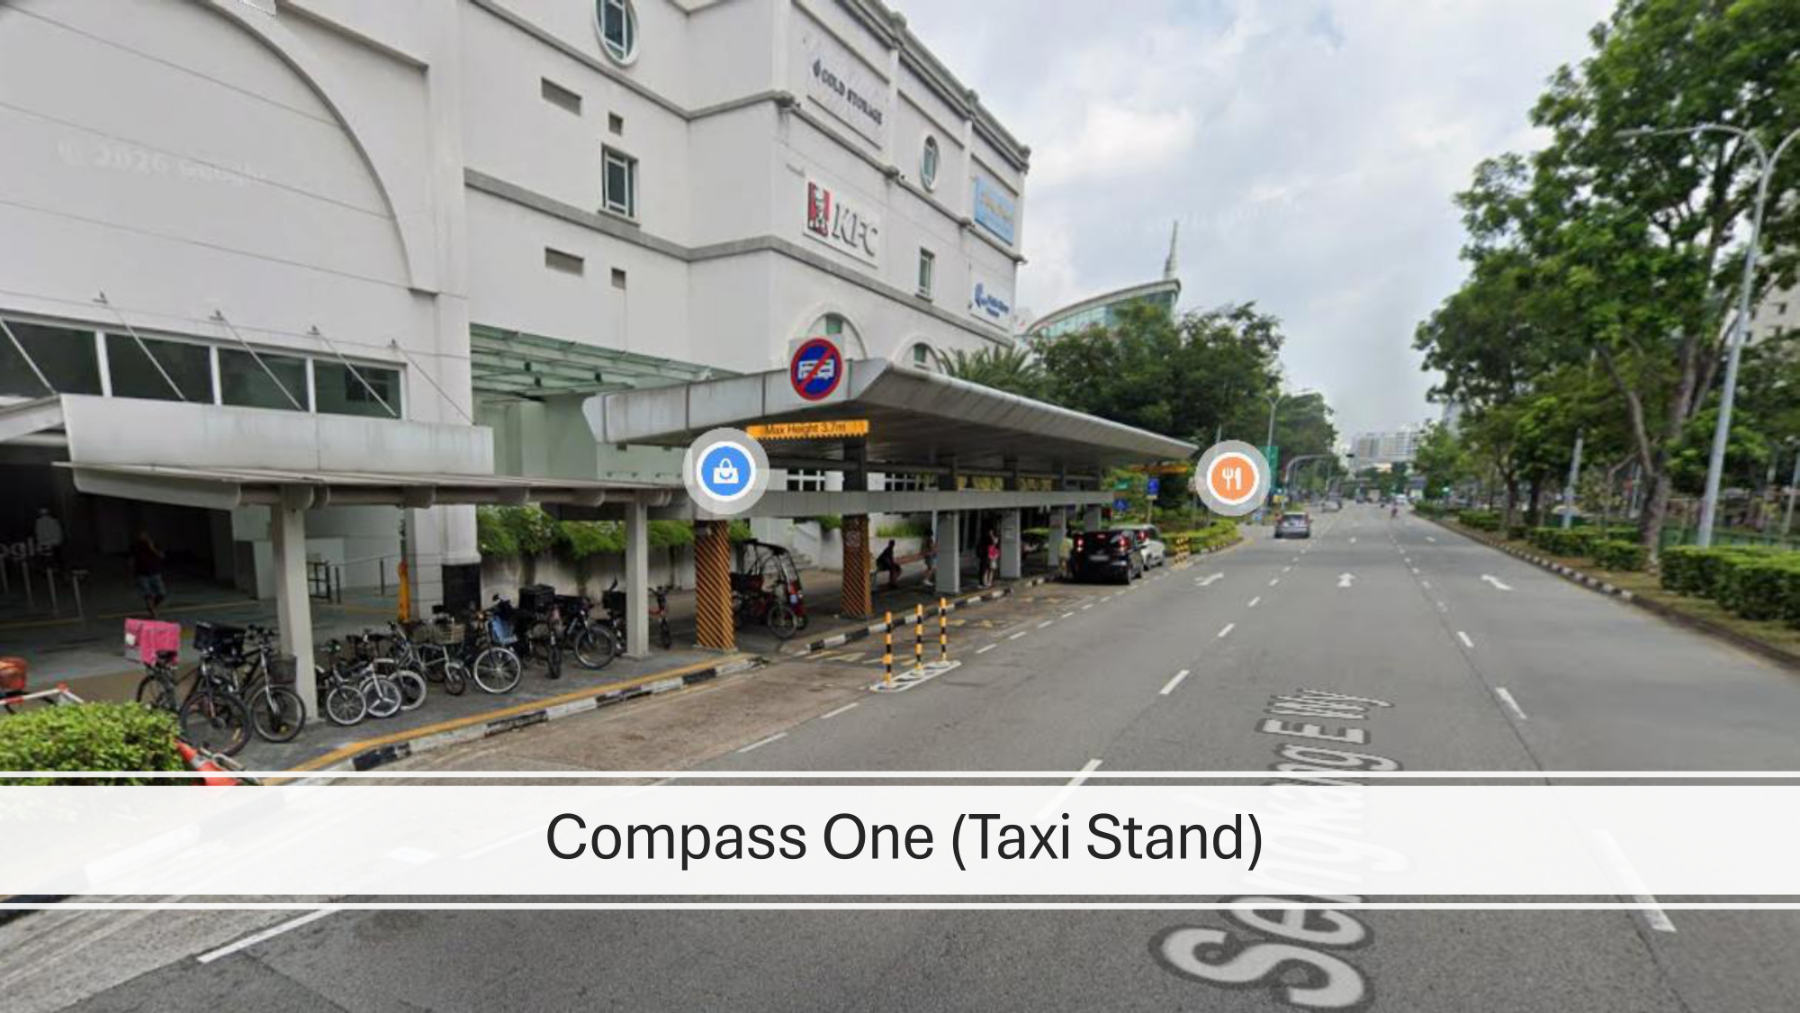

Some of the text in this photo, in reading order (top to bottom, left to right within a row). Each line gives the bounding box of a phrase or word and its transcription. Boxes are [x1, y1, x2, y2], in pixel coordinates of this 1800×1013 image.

[821, 67, 846, 97] COLD
[831, 202, 879, 258] KFC
[765, 421, 847, 435] Max Height 3.7m
